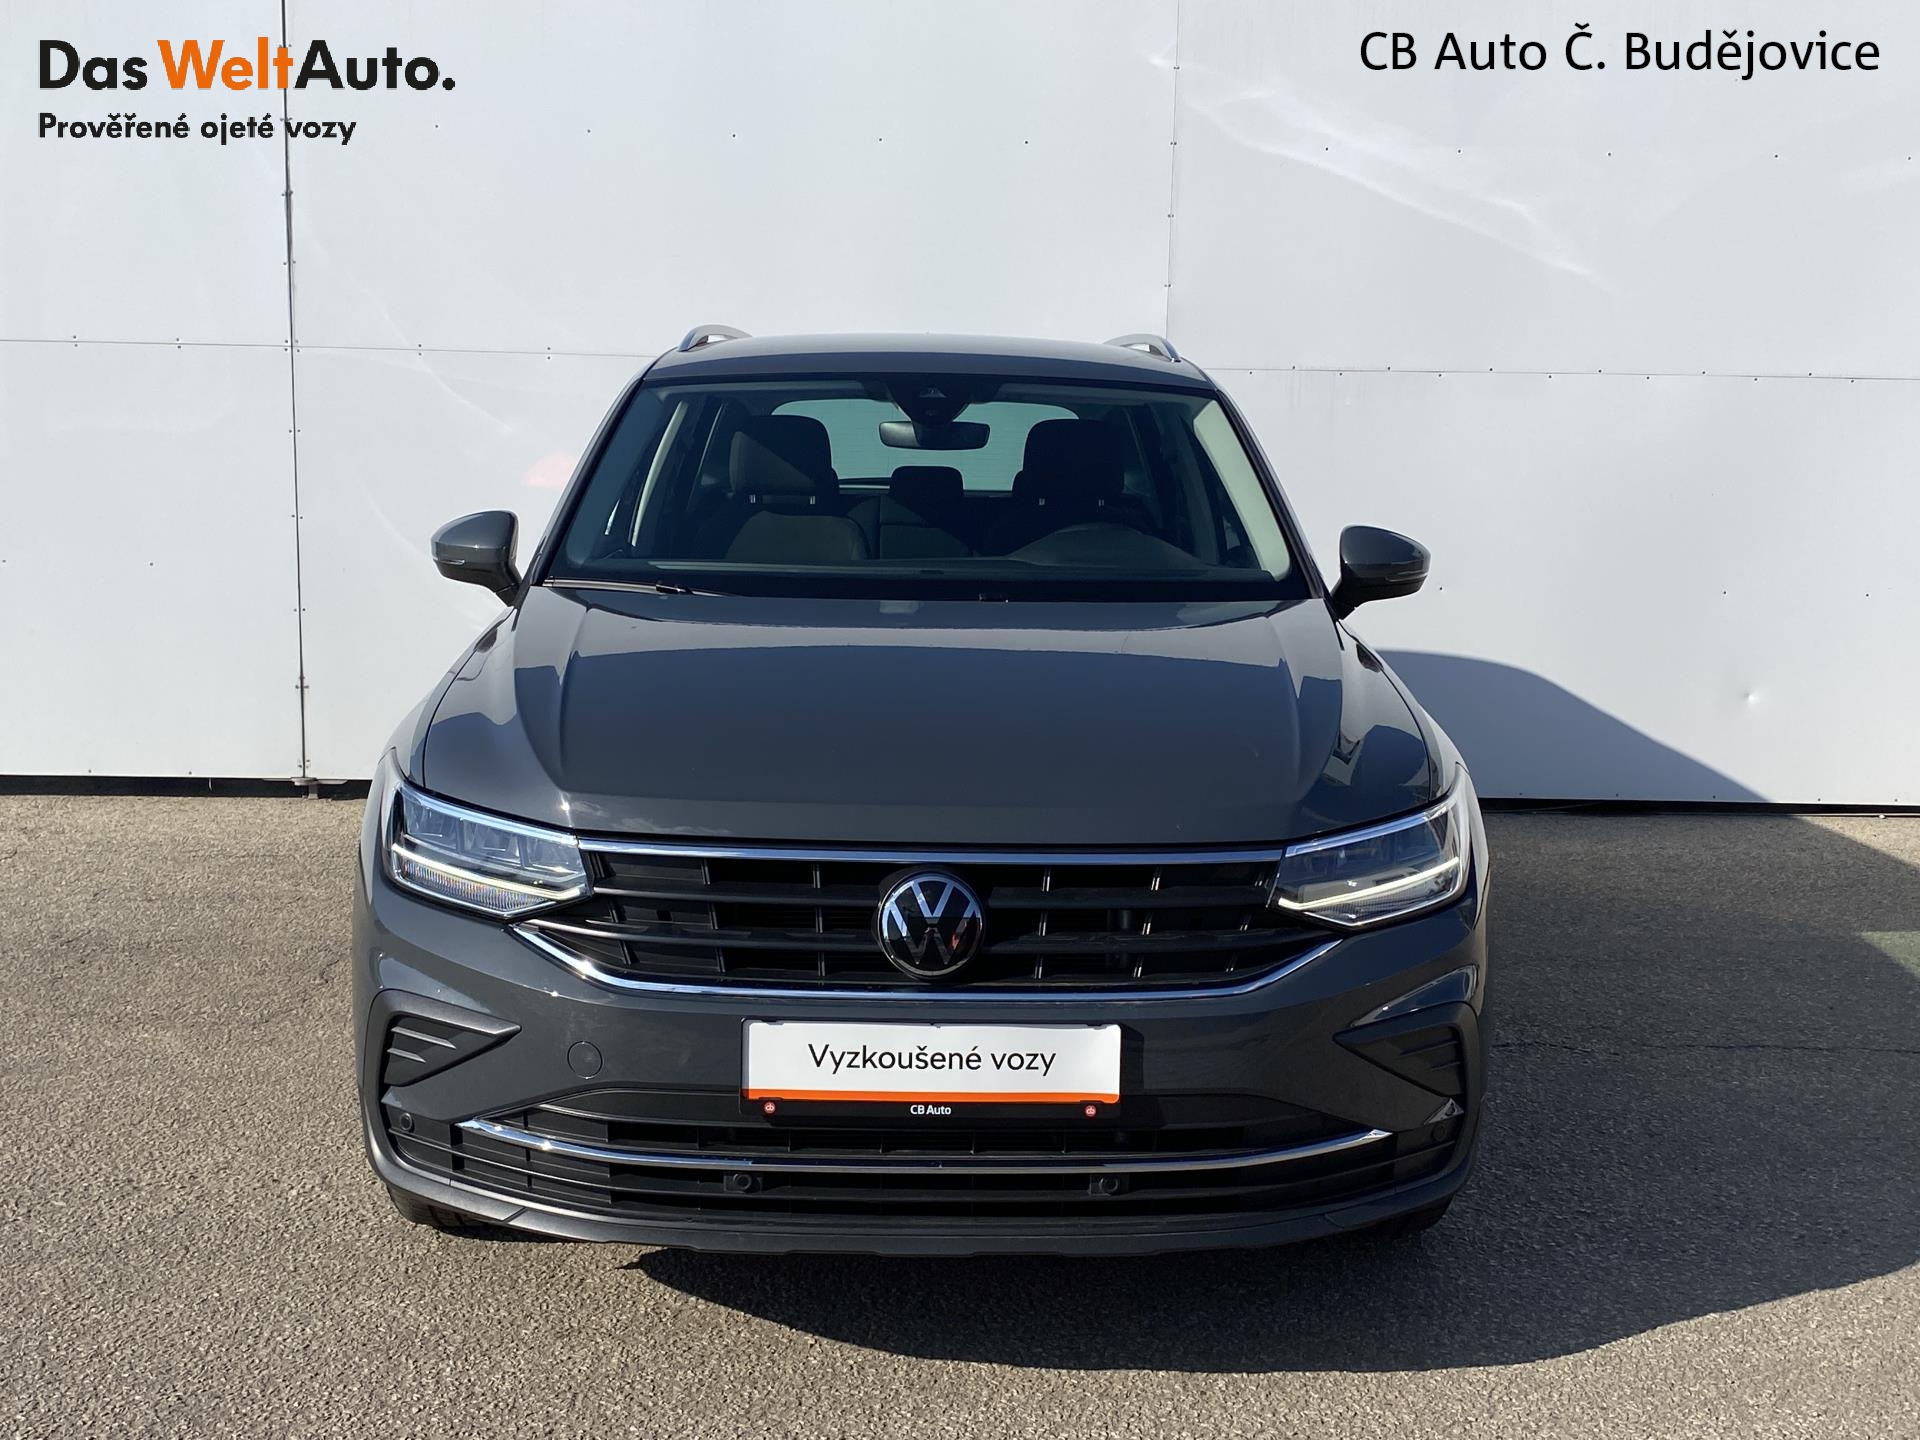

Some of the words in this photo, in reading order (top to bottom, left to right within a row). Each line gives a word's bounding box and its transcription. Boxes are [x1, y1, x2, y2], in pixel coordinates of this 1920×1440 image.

[808, 1043, 982, 1074] Vyzkoušené
[990, 1052, 1056, 1076] vozy
[910, 1104, 925, 1115] CB
[926, 1104, 952, 1115] Auto
